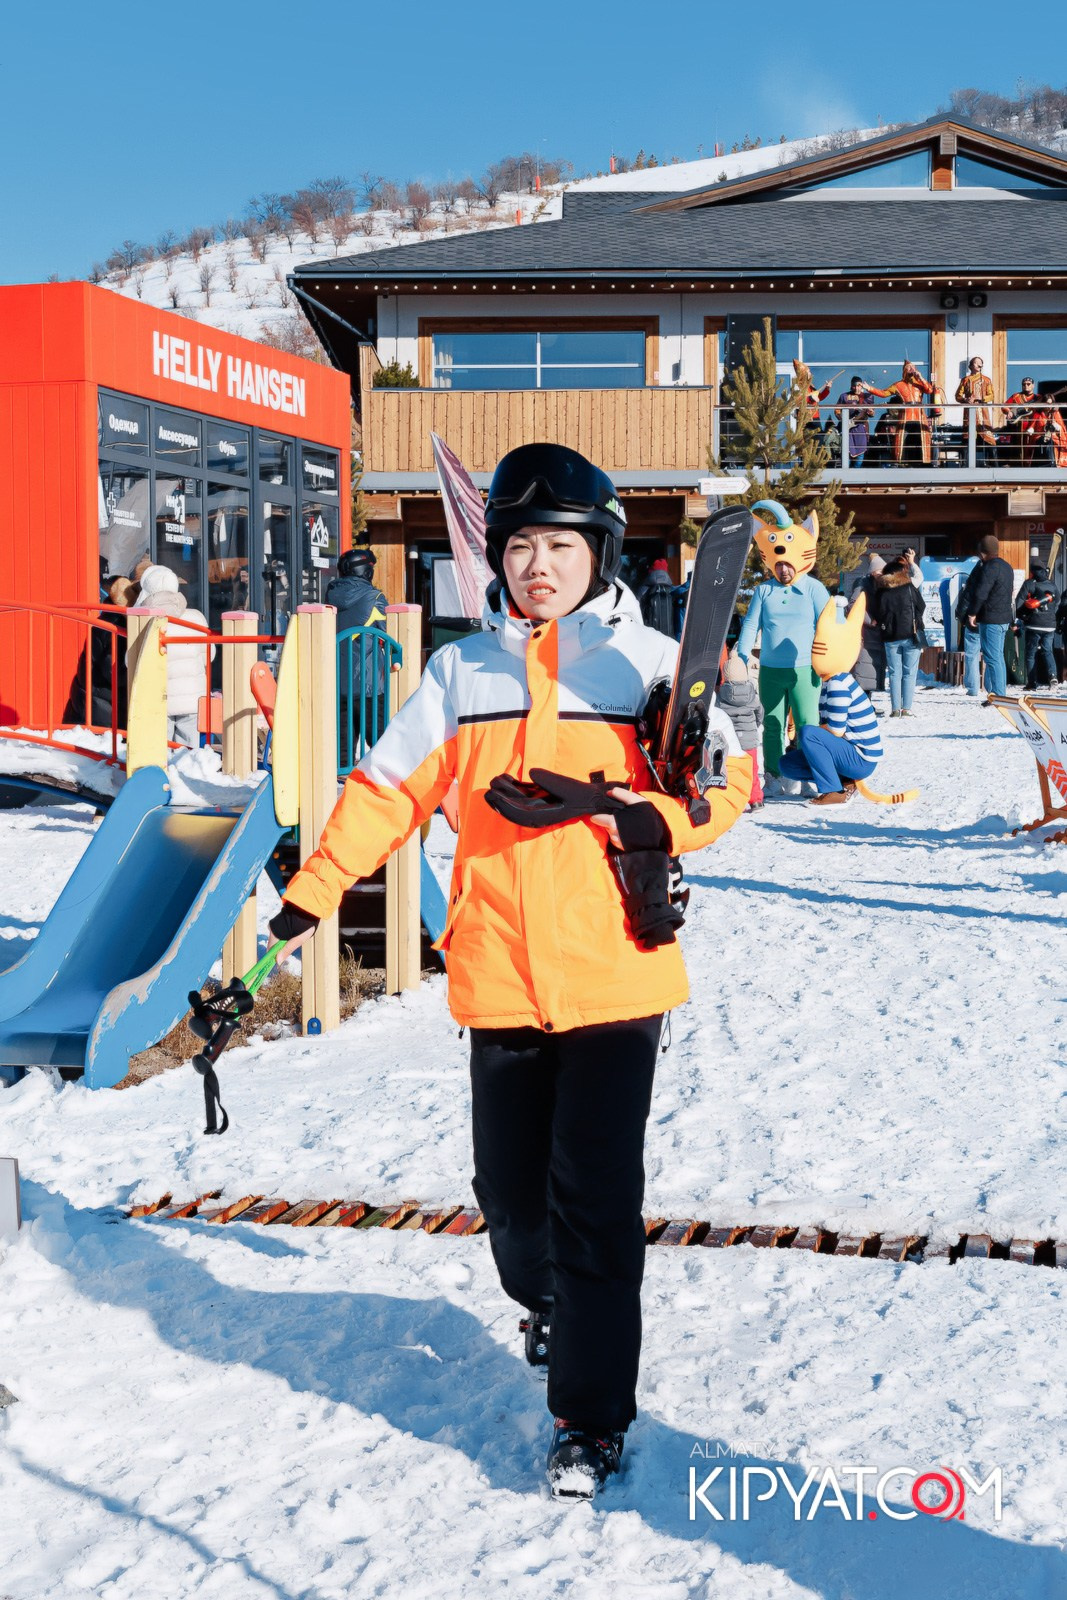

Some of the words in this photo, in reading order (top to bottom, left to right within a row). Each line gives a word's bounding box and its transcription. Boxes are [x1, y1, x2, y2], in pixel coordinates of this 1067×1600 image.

[153, 330, 222, 393] HELLY
[227, 355, 305, 417] HANSEN
[108, 413, 139, 436] Одежда
[158, 425, 198, 448] Аксессуары
[218, 440, 237, 457] Обувь
[1028, 520, 1045, 534] ОД
[599, 702, 633, 712] Columbia
